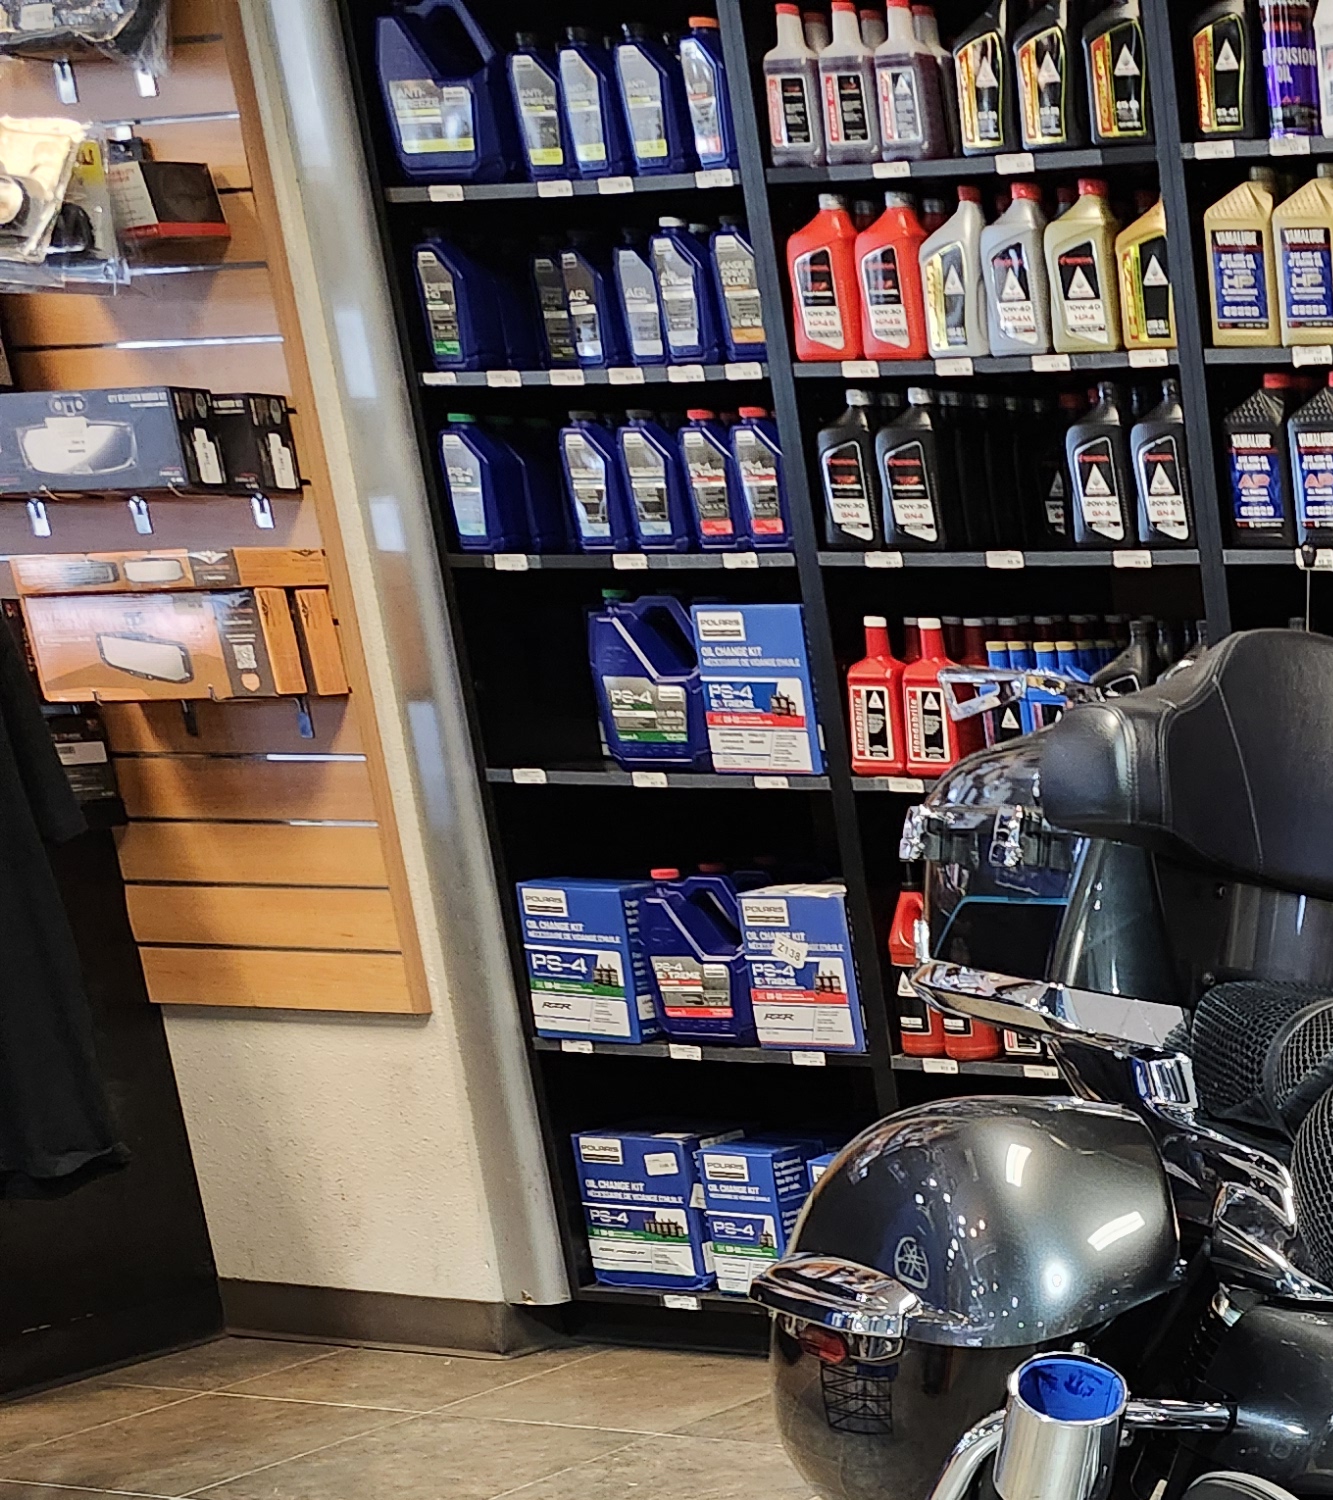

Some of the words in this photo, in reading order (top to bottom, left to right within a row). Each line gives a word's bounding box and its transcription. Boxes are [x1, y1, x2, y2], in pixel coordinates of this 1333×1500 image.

[1215, 230, 1257, 246] YAMALUBE
[1284, 228, 1326, 244] YAMALUBE
[569, 289, 590, 301] AGL
[1231, 433, 1272, 449] YAMALUBE
[699, 618, 741, 627] POLARIS
[610, 688, 653, 705] PS-4
[708, 684, 753, 701] PS-4
[854, 697, 867, 752] Hondabrite
[909, 697, 921, 753] Hondabrite
[525, 895, 563, 904] POLARIS
[745, 905, 784, 914] POLARIS
[776, 942, 801, 962] Z138
[531, 953, 589, 974] PS-4
[706, 1161, 745, 1170] POLARIS
[713, 1221, 755, 1236] PS-4
